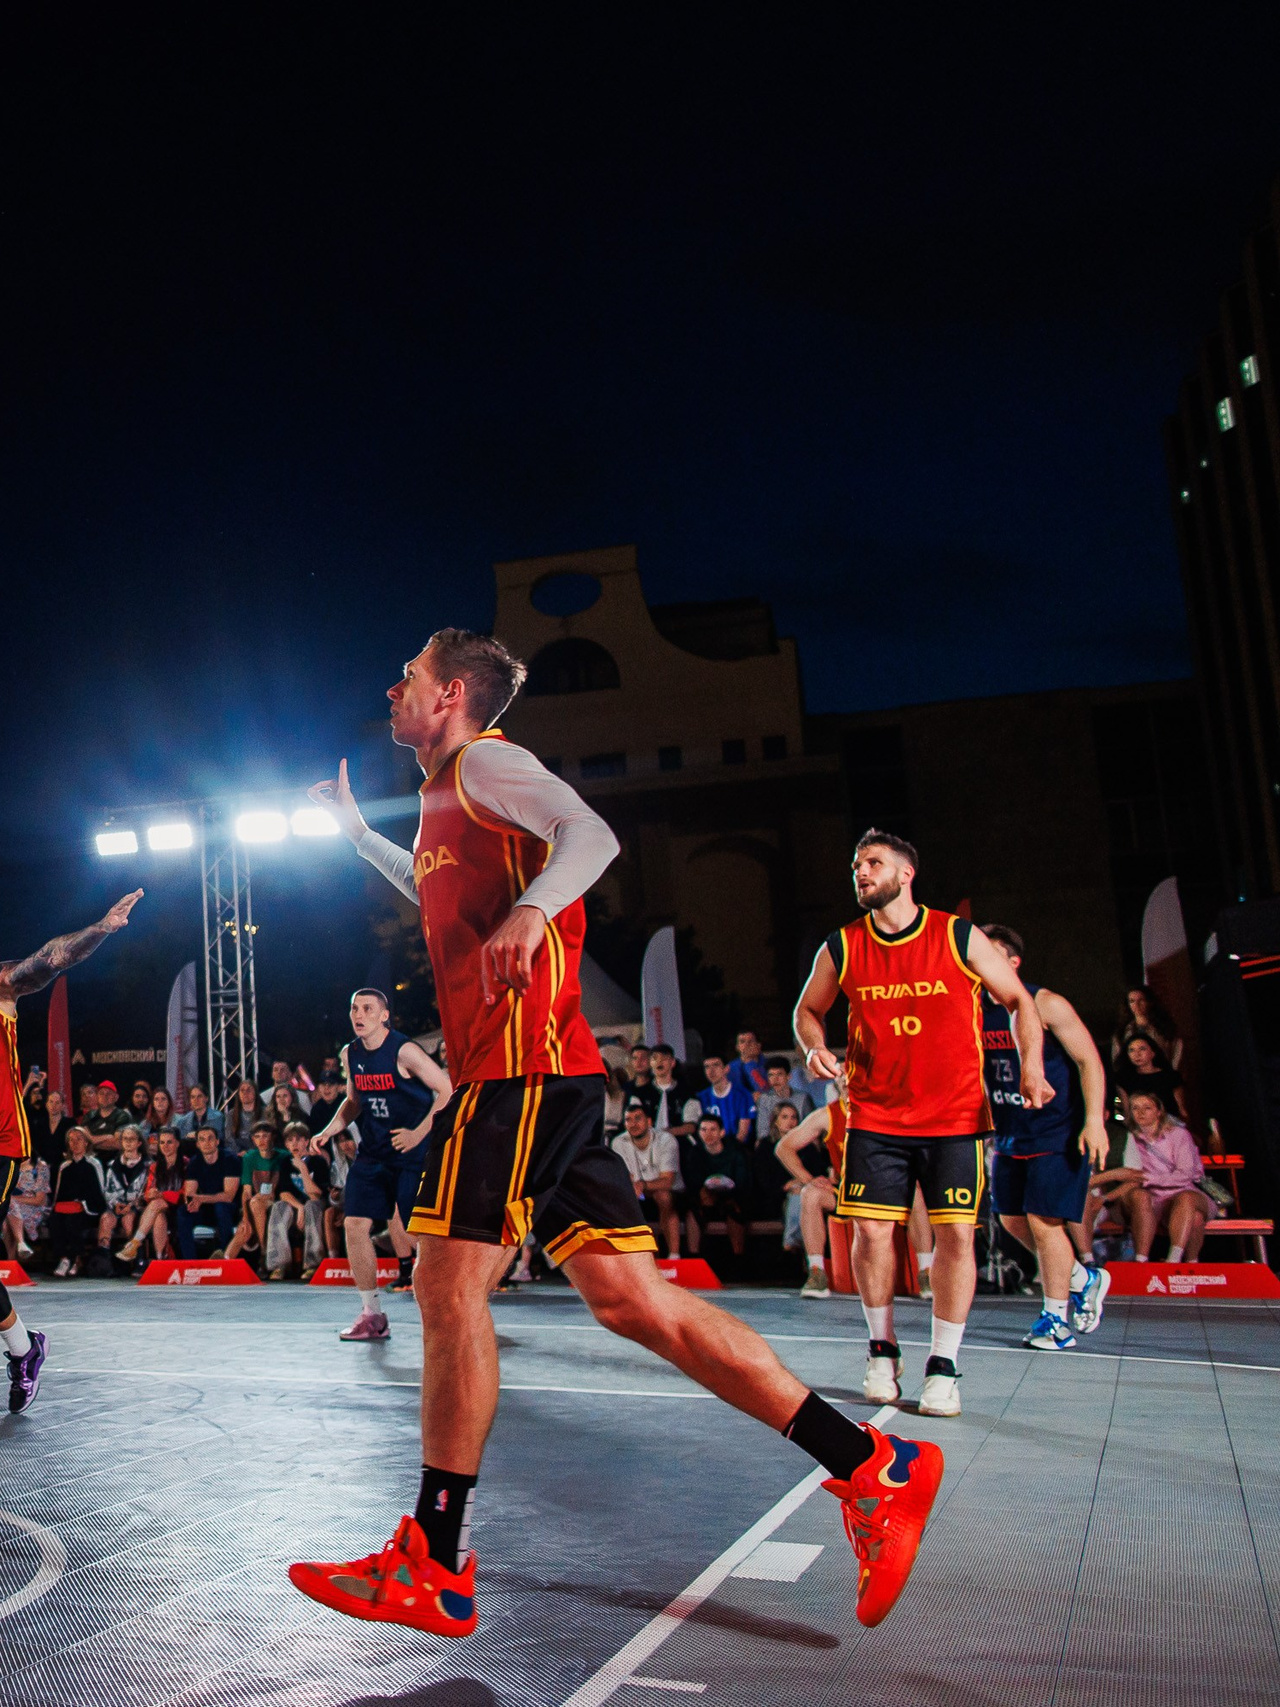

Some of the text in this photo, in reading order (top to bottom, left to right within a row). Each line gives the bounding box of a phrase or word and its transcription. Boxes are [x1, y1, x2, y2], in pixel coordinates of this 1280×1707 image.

[889, 1015, 922, 1036] 10
[354, 1073, 396, 1091] RUSSIA
[368, 1097, 390, 1118] 33
[944, 1187, 972, 1205] 10
